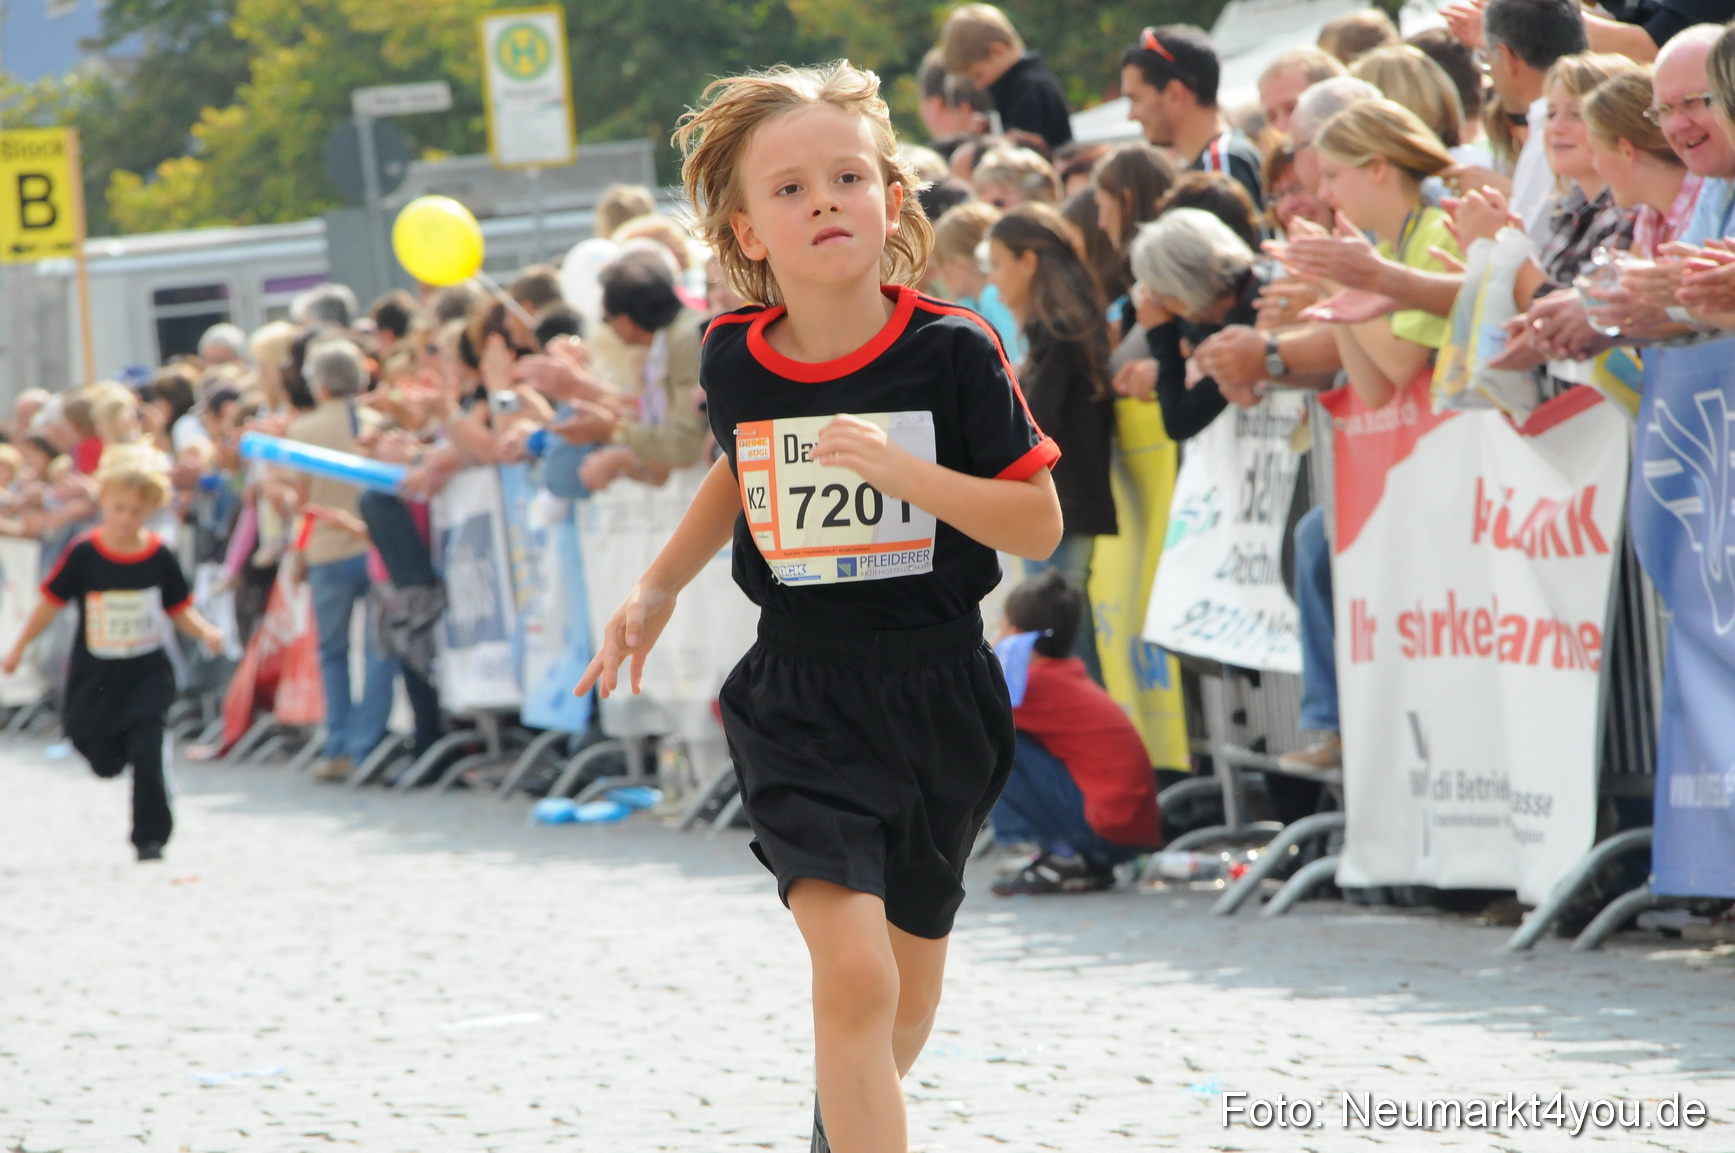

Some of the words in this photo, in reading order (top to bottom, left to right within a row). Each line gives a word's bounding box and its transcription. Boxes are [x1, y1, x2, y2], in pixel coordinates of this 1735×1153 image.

[17, 173, 58, 230] B
[747, 486, 766, 510] K2
[788, 481, 911, 530] 7201
[860, 549, 930, 568] PFLEIDERER
